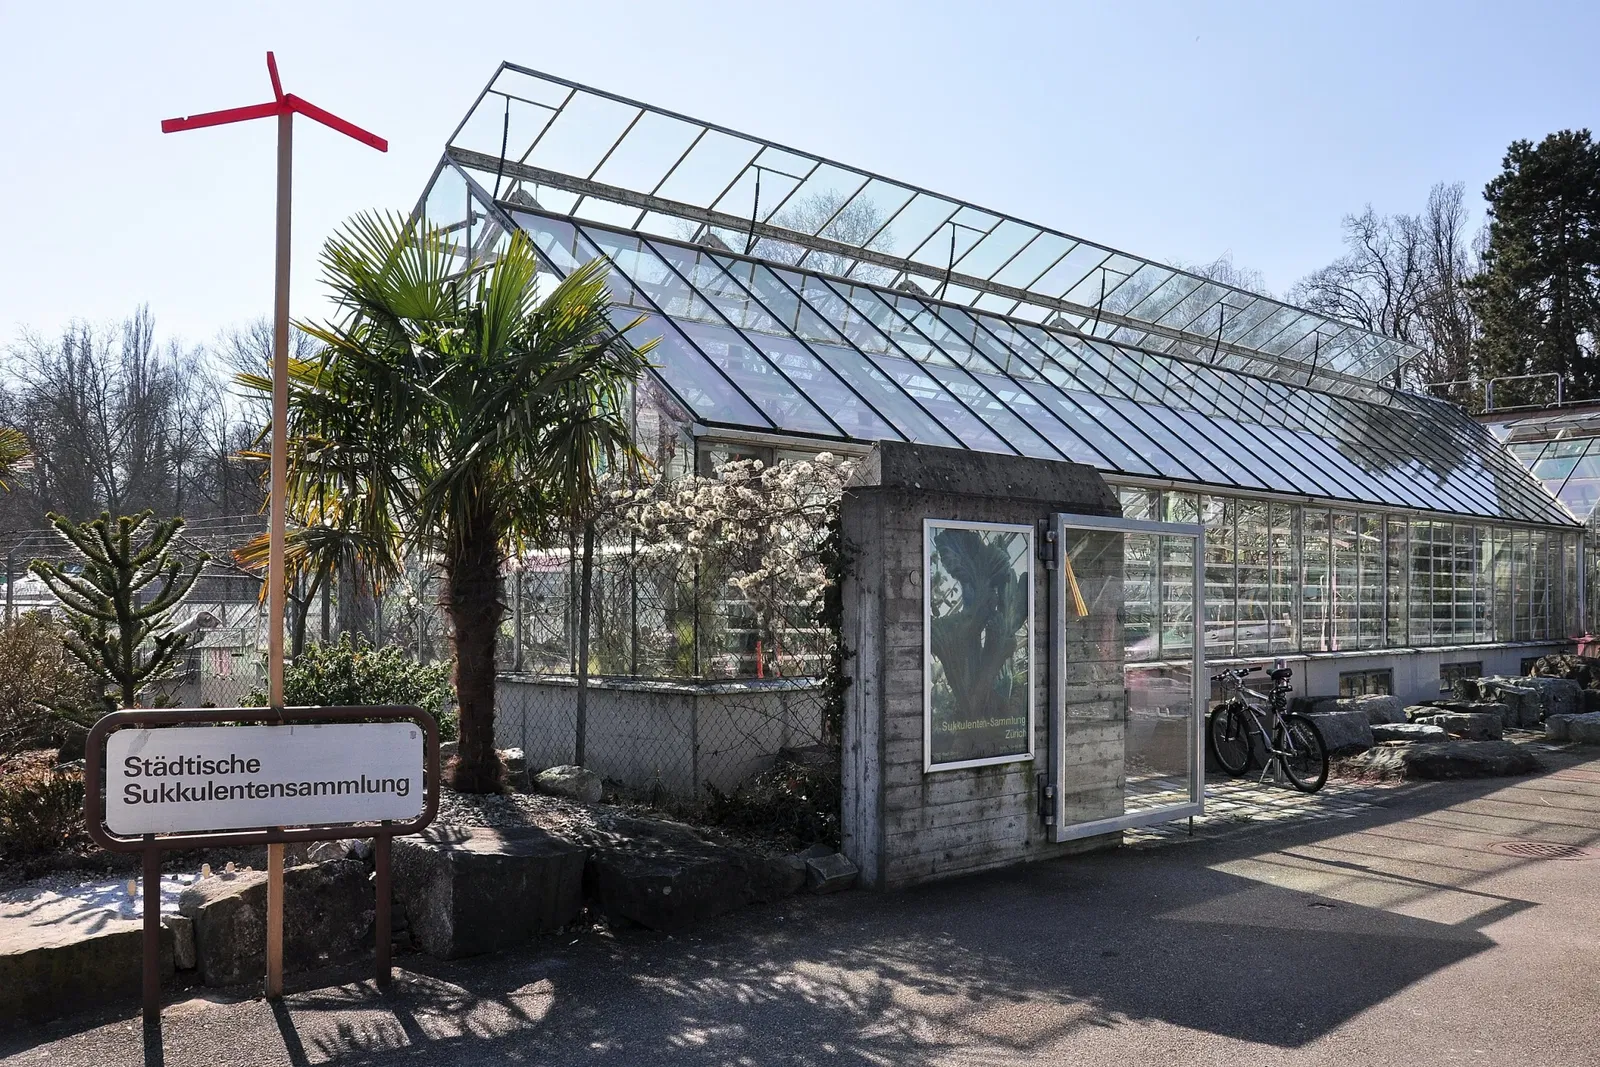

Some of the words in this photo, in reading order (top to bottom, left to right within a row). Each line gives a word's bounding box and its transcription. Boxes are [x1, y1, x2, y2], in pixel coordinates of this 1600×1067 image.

[942, 716, 1026, 732] Sukkulenten-Sammlung
[1005, 729, 1027, 739] Zürich
[123, 754, 261, 778] Städtische
[123, 774, 410, 805] Sukkulentensammlung
